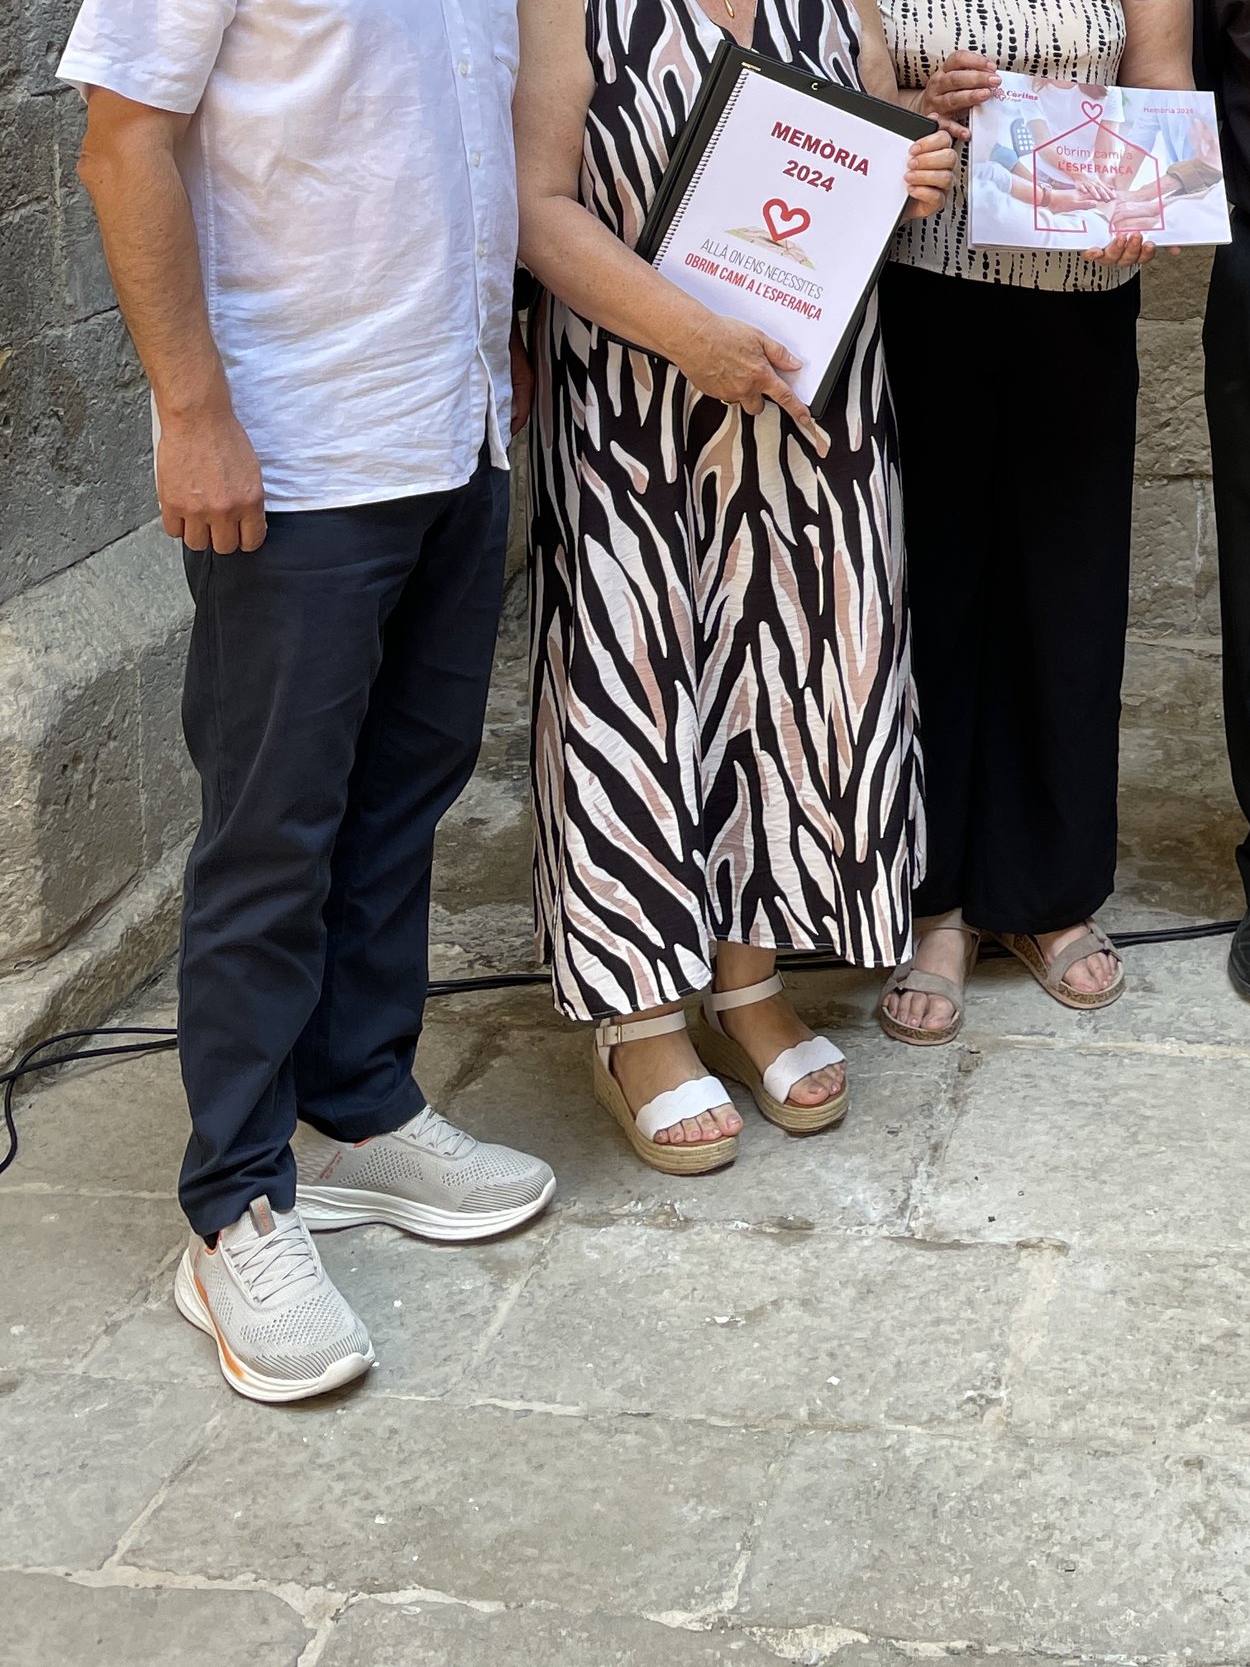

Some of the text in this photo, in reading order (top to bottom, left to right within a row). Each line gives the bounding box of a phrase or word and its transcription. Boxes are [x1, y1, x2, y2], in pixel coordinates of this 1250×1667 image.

[771, 121, 870, 176] MEMÒRIA
[783, 159, 835, 192] 2024
[1056, 145, 1091, 158] Obrim
[684, 253, 822, 320] OBRIM CAMÍ A L'ESPERANÇA
[700, 239, 824, 299] ALLÀ ON ENS NECESSITES
